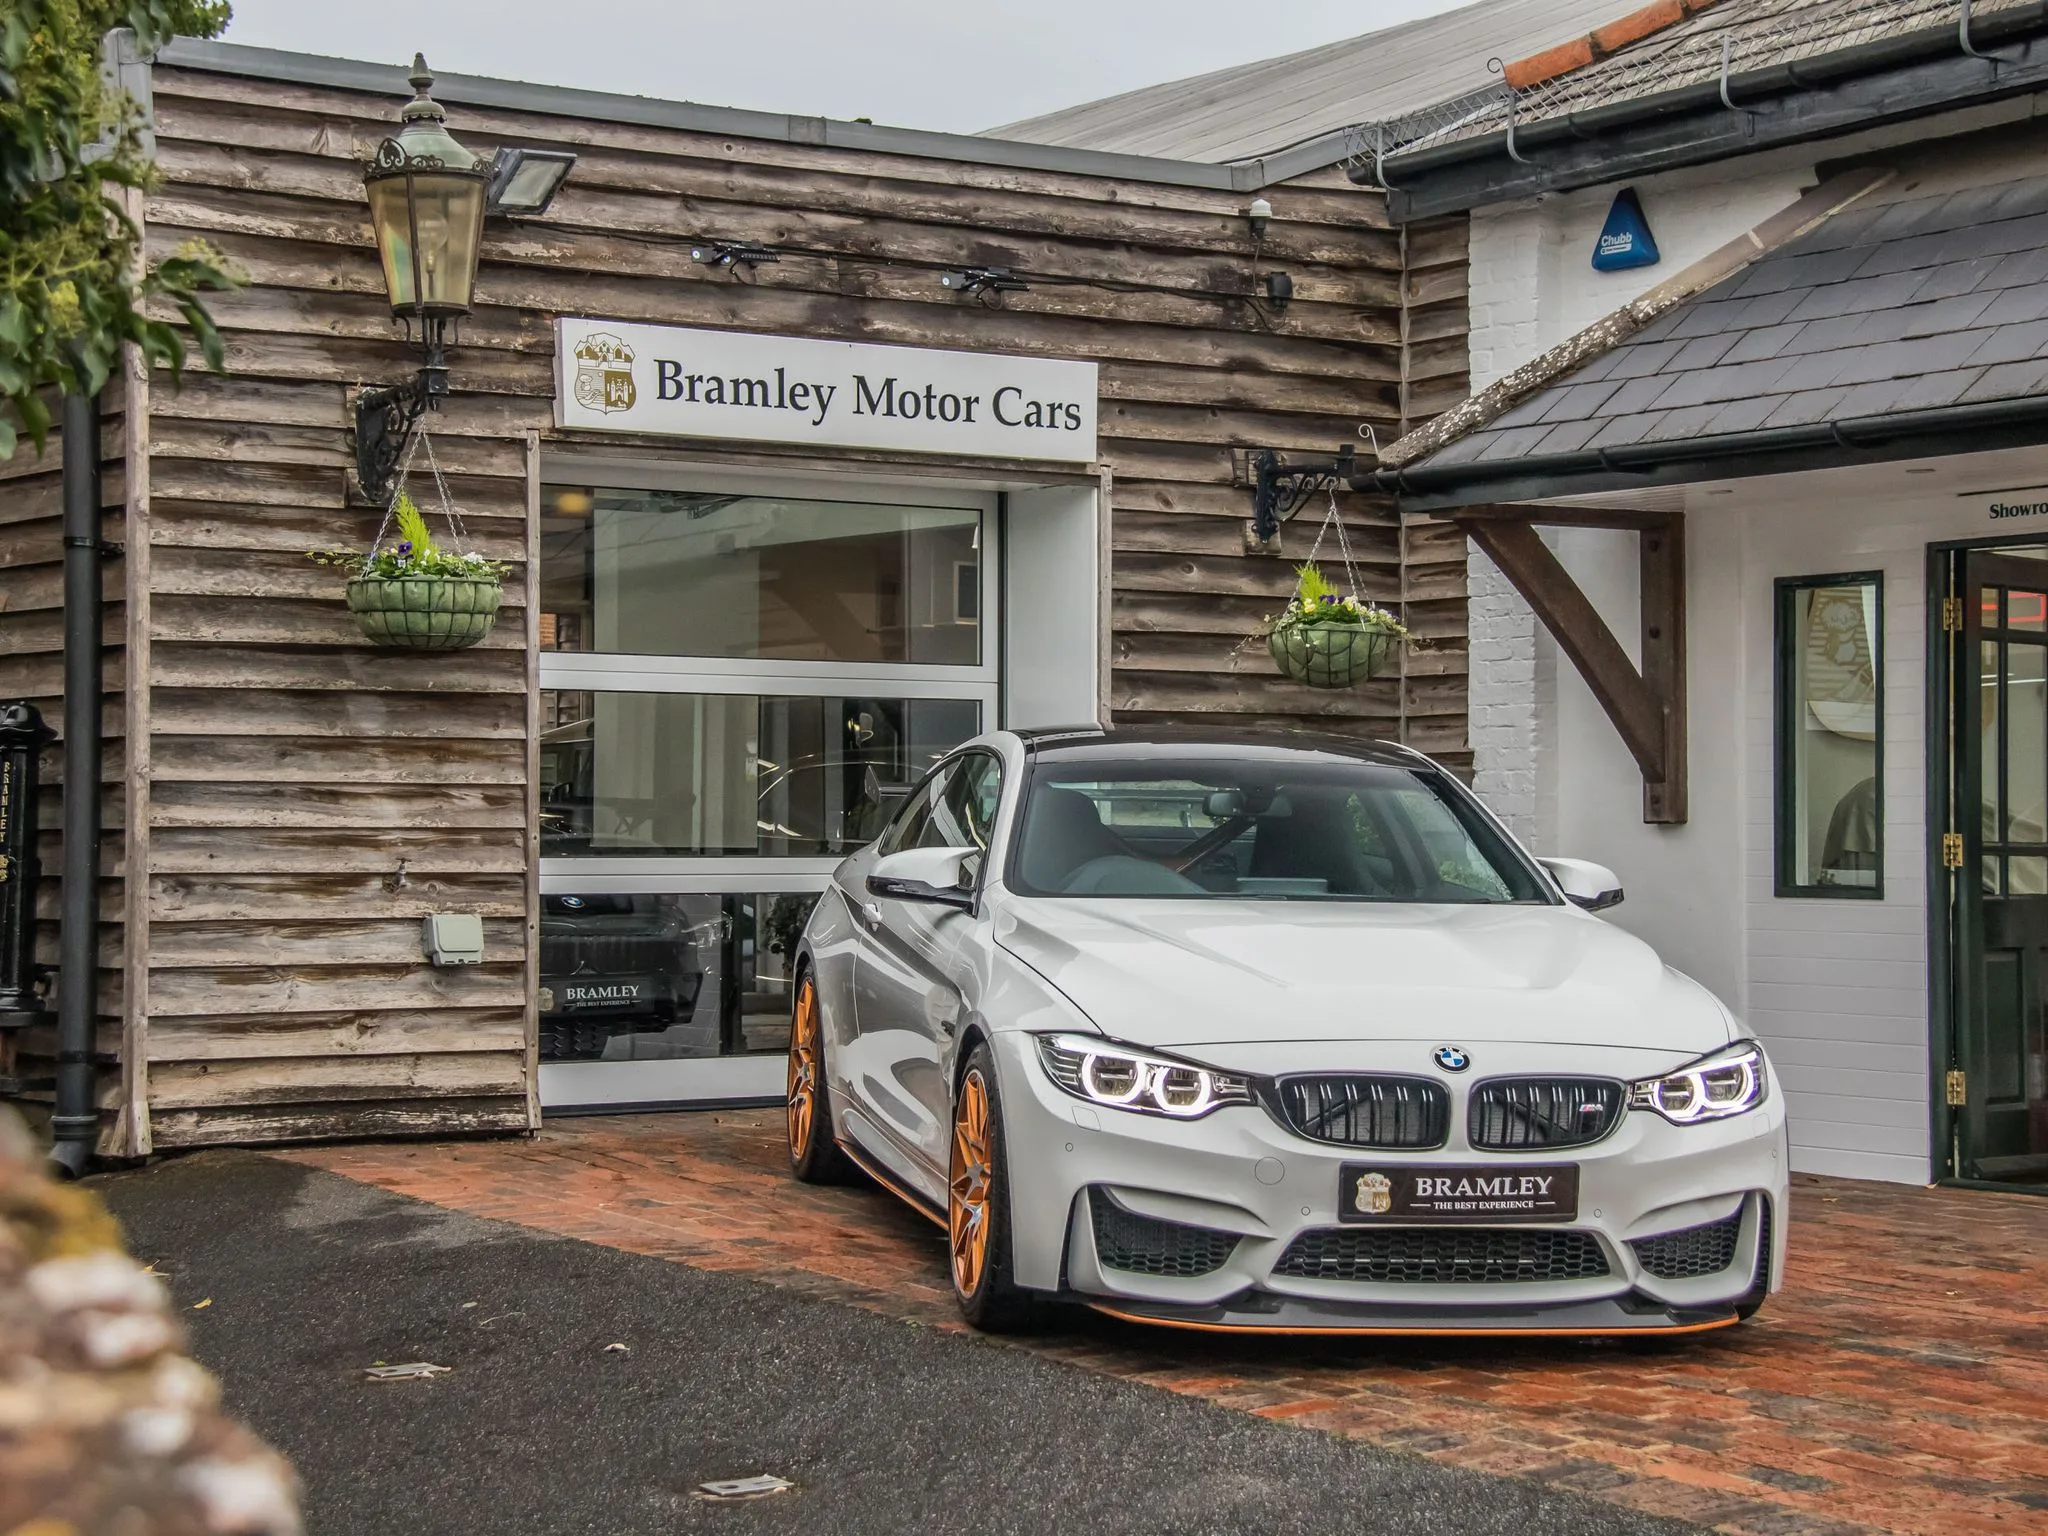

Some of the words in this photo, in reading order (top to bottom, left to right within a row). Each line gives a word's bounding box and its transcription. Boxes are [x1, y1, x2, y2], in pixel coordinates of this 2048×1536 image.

[1601, 232, 1632, 246] Chubb
[653, 359, 837, 426] Bramley
[852, 375, 979, 423] Motor
[992, 386, 1081, 431] Cars
[566, 984, 639, 1000] BRAMLEY
[1415, 1176, 1553, 1197] BRAMLEY
[1433, 1201, 1453, 1210] THE
[1454, 1201, 1477, 1210] BEST
[1479, 1200, 1534, 1210] EXPERIENCE
